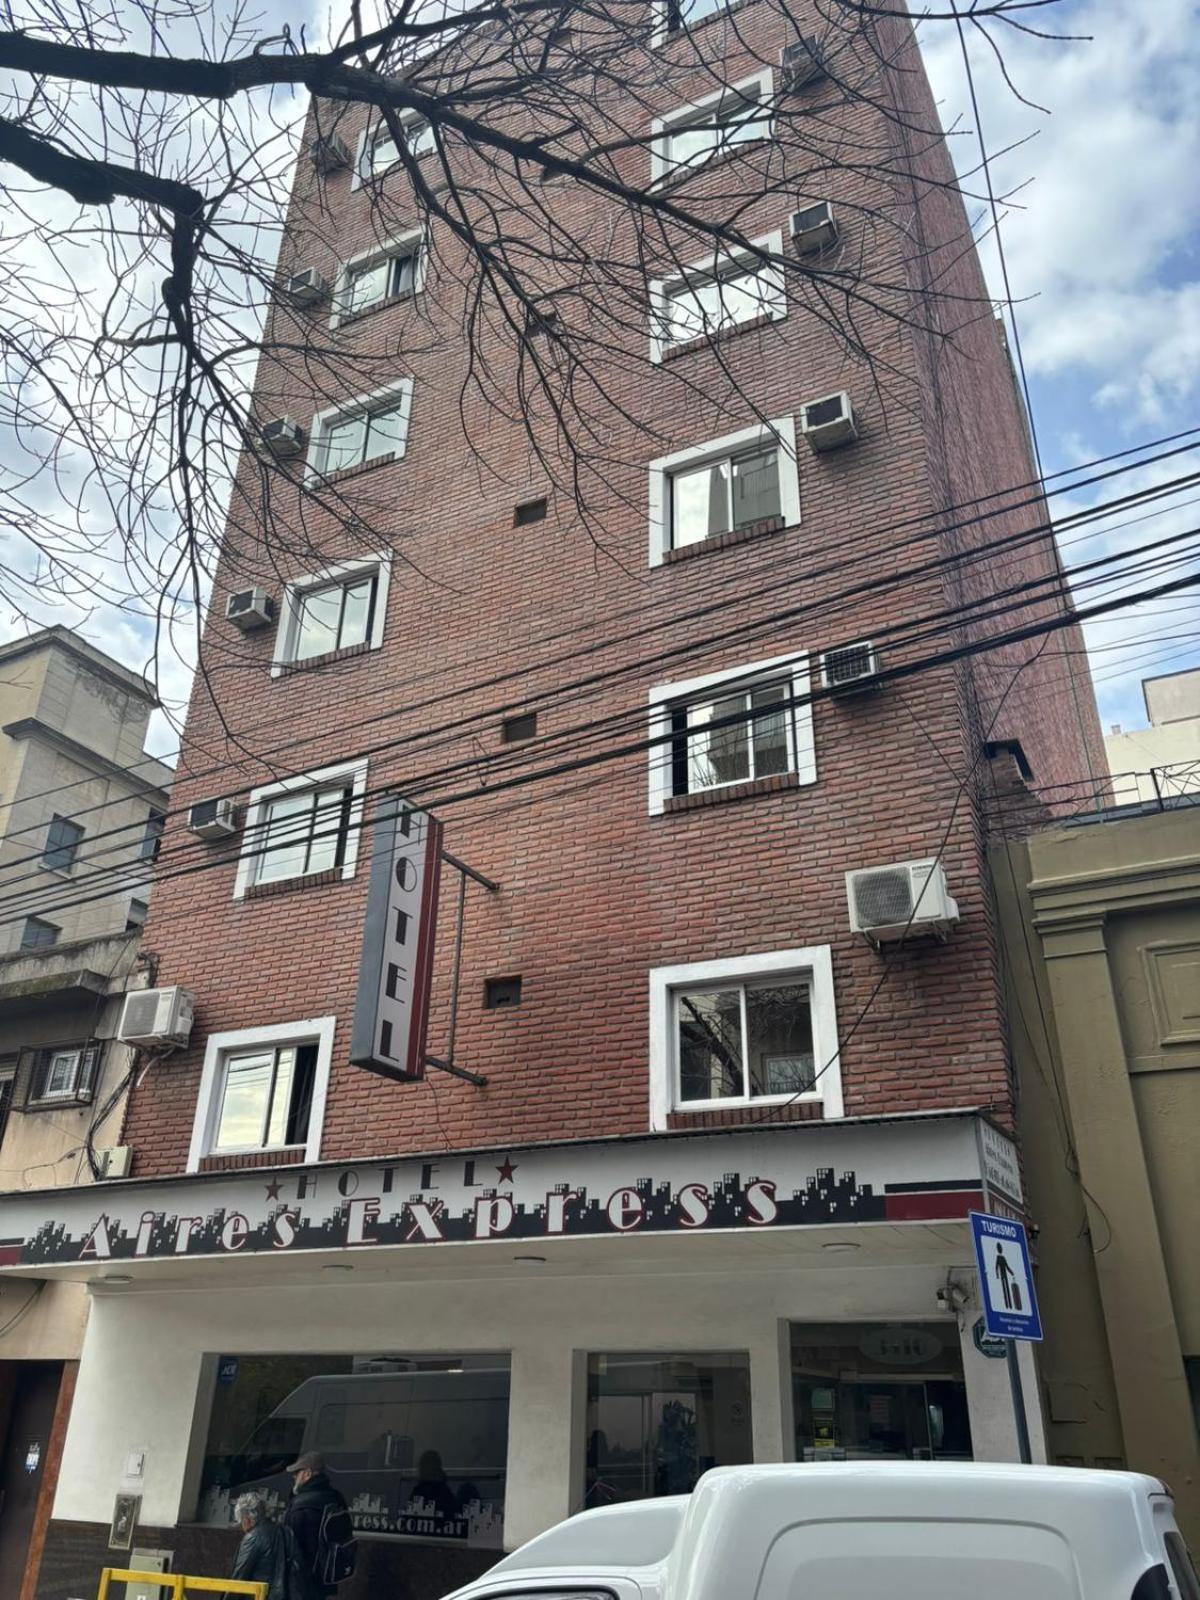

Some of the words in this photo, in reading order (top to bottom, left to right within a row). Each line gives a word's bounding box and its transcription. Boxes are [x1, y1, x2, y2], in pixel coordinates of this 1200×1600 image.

[379, 803, 422, 1062] HOTEL
[297, 1160, 483, 1199] HOTEL
[79, 1209, 300, 1261] Aires
[345, 1179, 778, 1248] Express
[980, 1220, 1017, 1238] TURISMO
[353, 1514, 465, 1536] ress.com.ar
